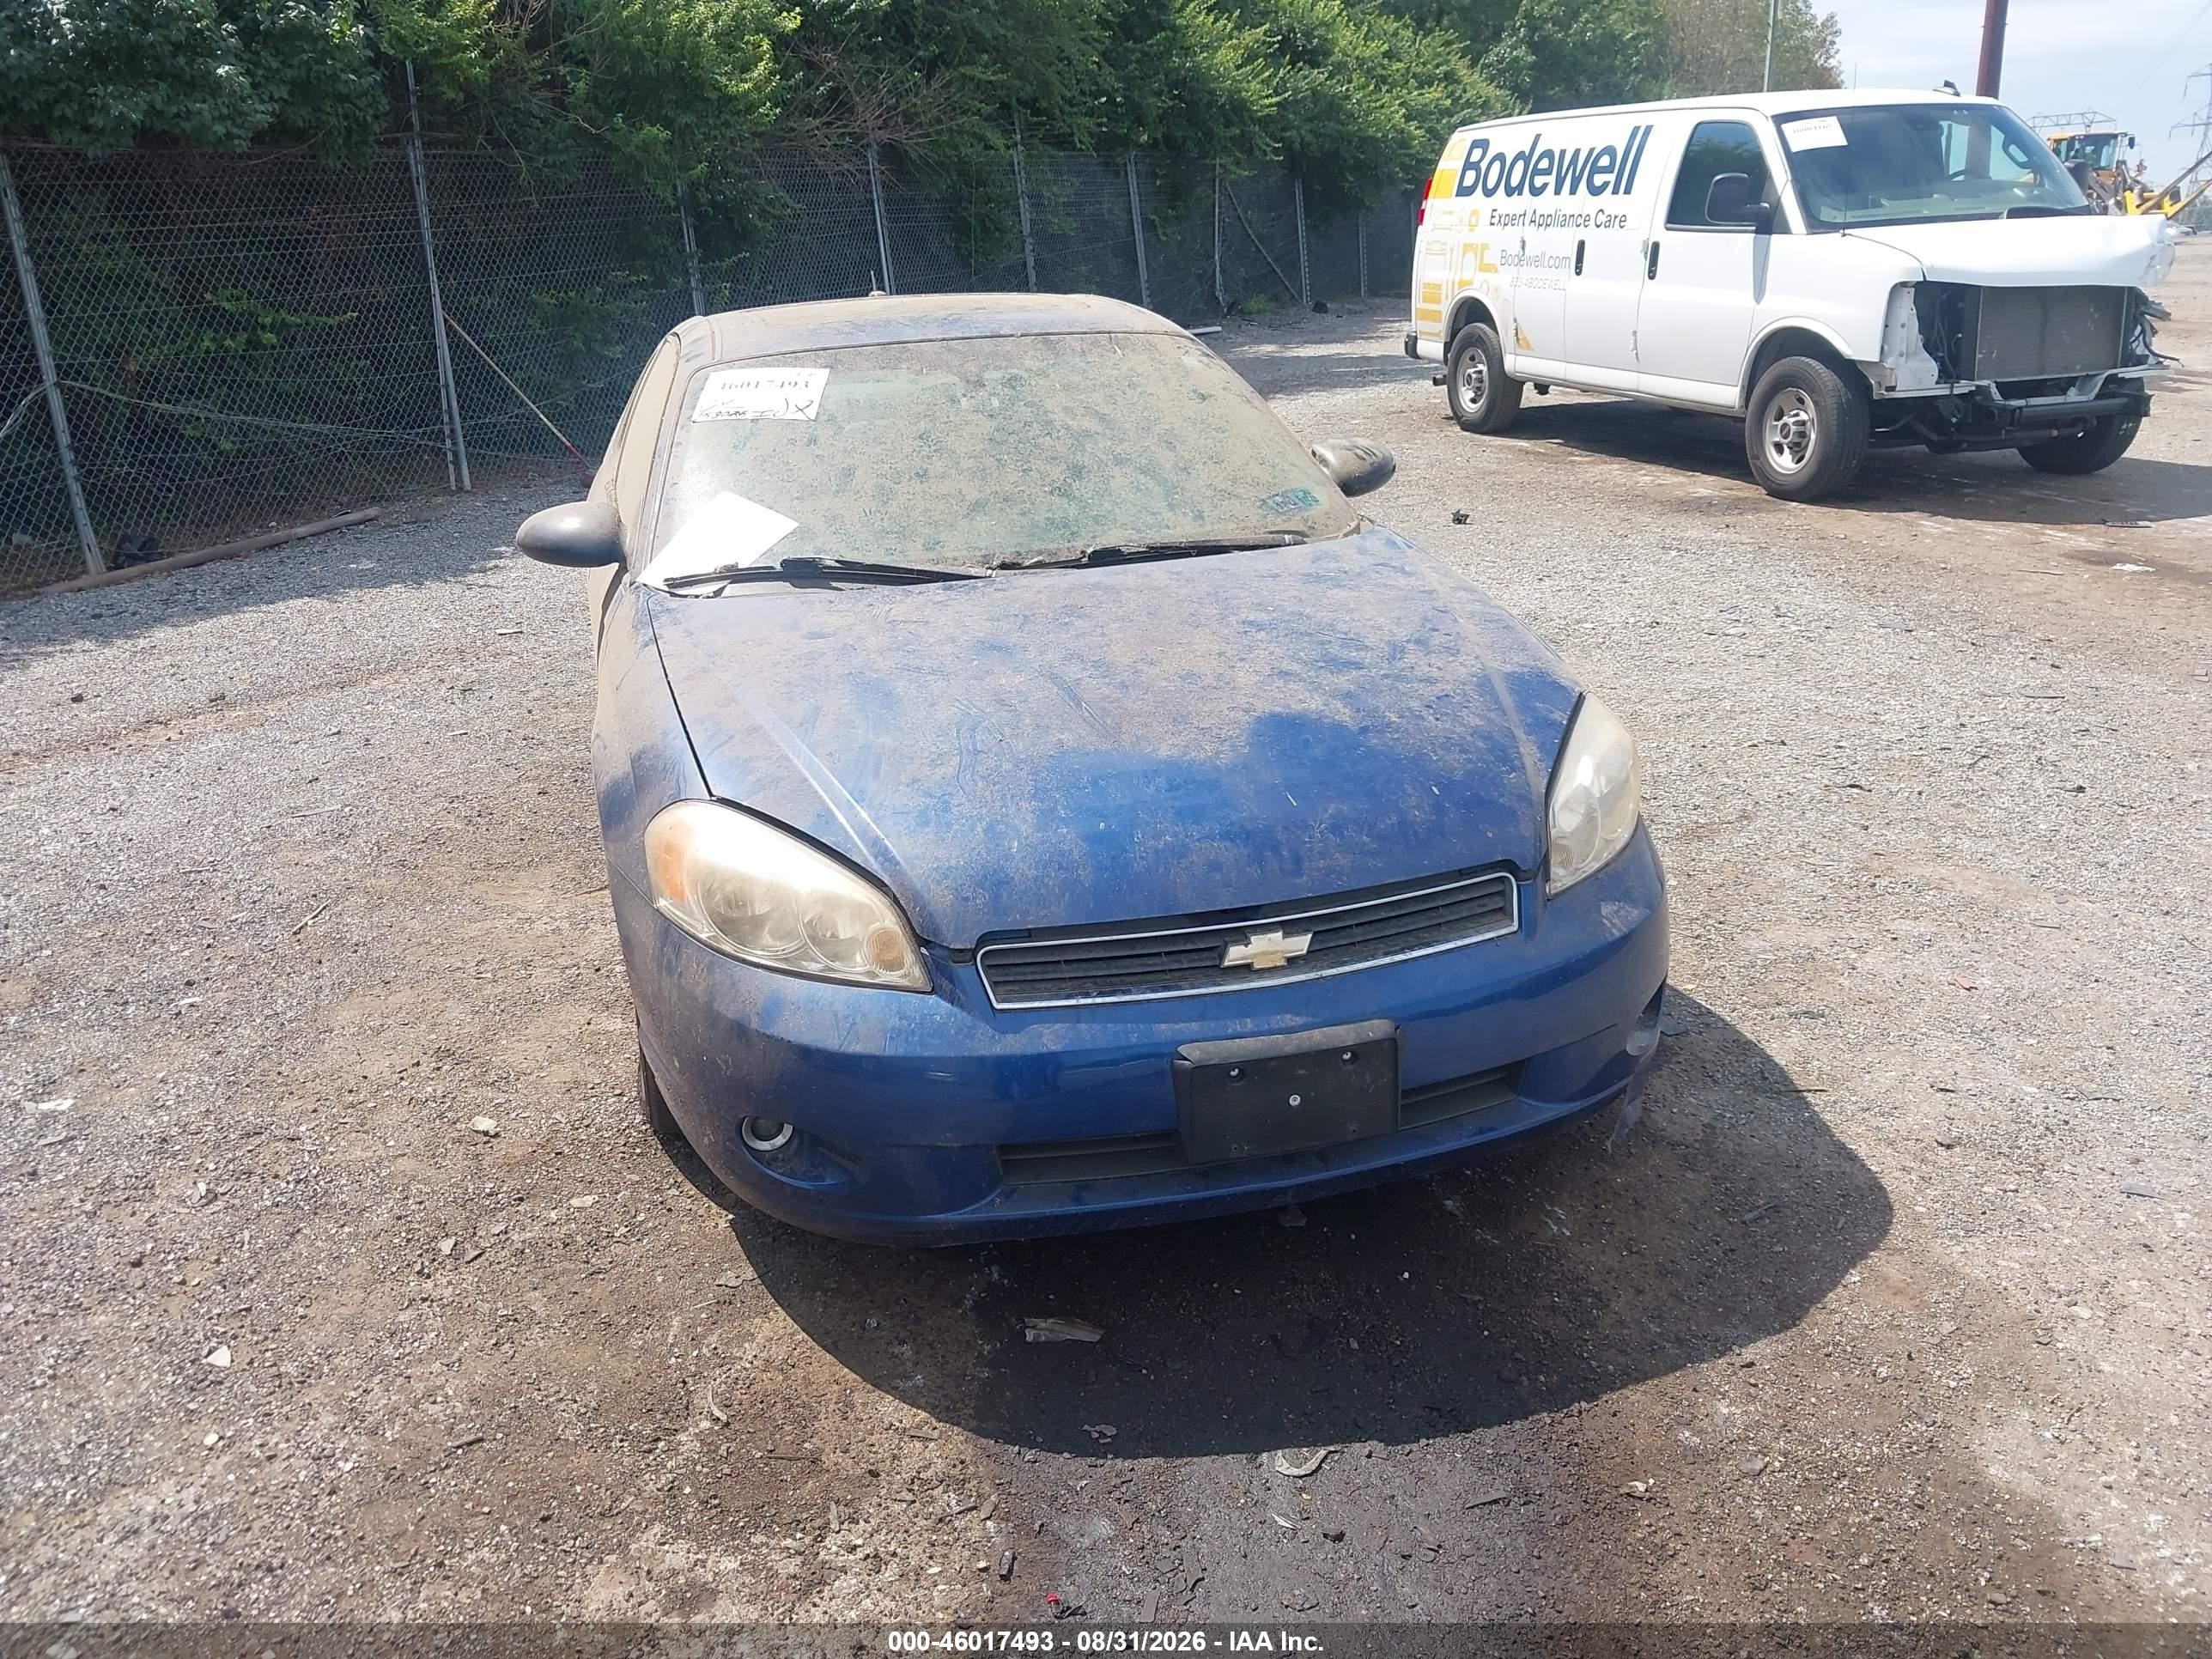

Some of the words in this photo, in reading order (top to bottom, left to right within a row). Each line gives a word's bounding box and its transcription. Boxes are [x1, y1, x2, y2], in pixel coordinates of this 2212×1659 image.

[1455, 125, 1654, 198] Bodewell
[1489, 209, 1527, 230] Expert
[1528, 208, 1590, 231] Appliance
[1594, 209, 1627, 229] Care
[1499, 249, 1571, 270] Bodewell.com
